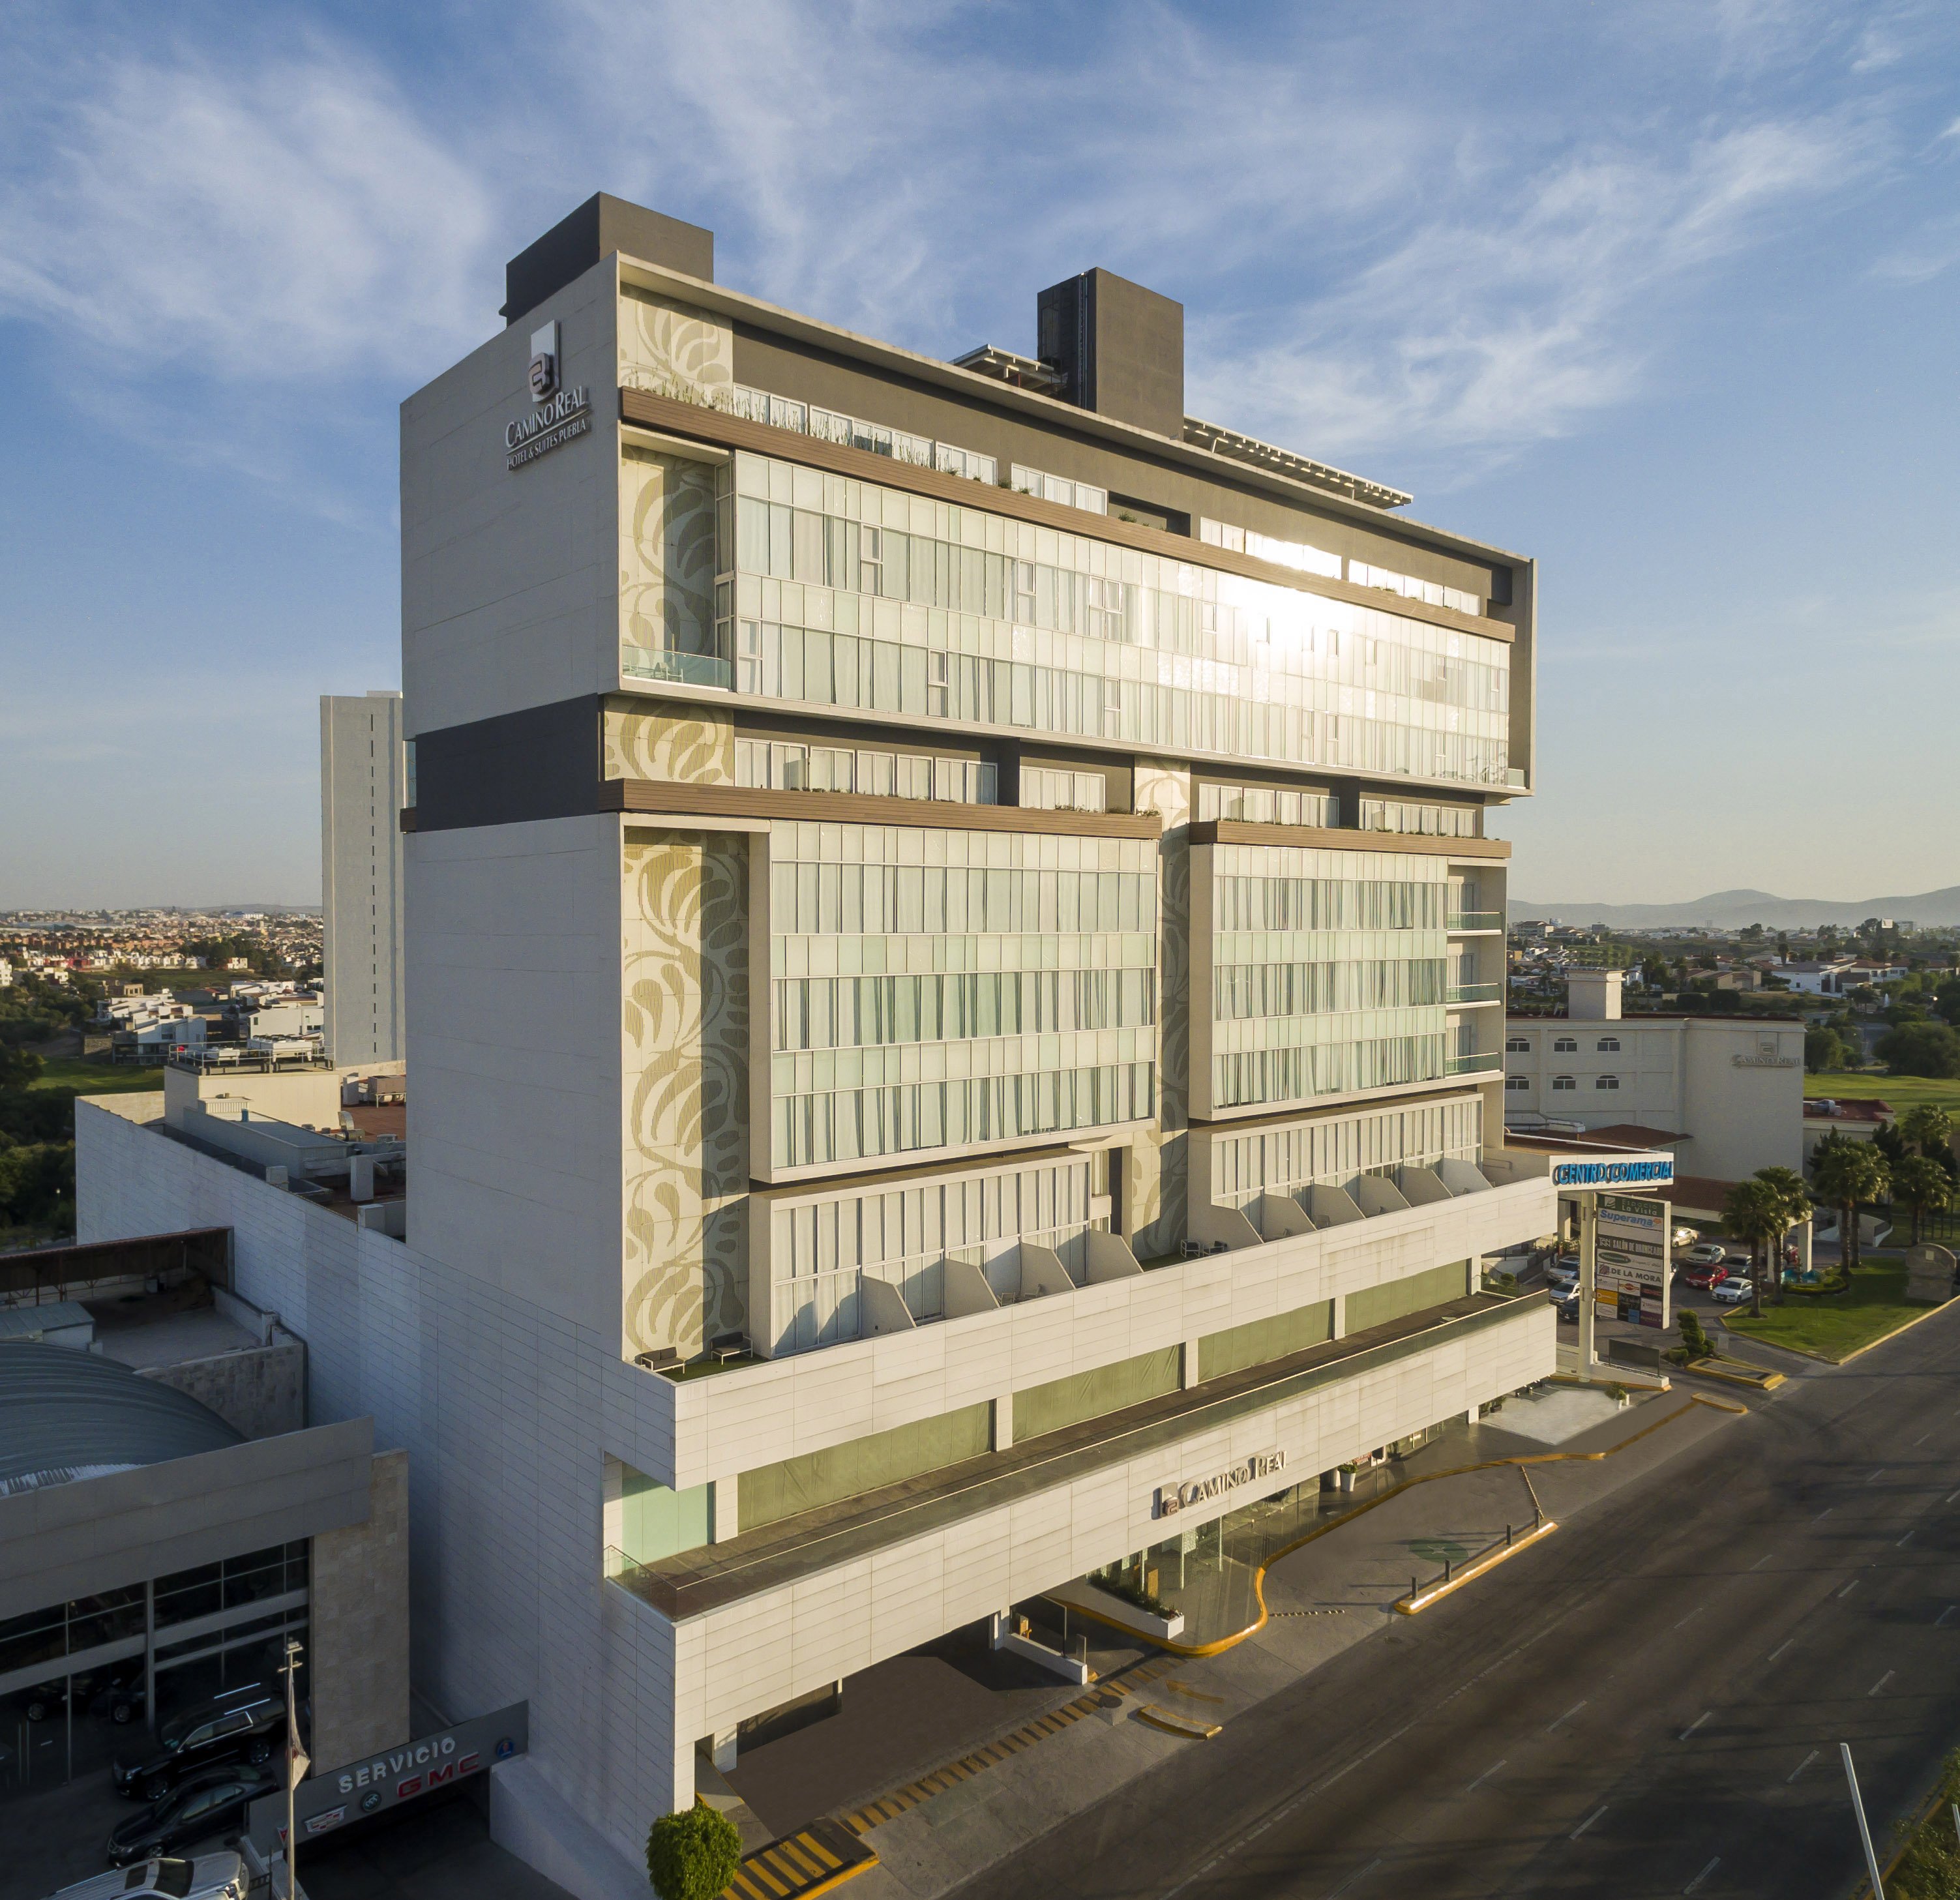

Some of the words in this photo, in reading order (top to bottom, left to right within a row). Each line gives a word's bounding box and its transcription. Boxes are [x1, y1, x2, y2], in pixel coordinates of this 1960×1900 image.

[505, 403, 554, 449] CAMINO
[556, 385, 586, 420] REAL
[507, 449, 528, 470] HOTEL
[528, 446, 535, 458] &
[535, 433, 558, 456] SUITES
[559, 418, 586, 443] PUEBLA
[1732, 1054, 1775, 1065] CAMINO
[1777, 1055, 1801, 1065] REAL
[1556, 1163, 1607, 1185] CENTRO
[1609, 1161, 1674, 1183] COMERCIAL
[1622, 1198, 1657, 1210] Espacio
[1634, 1206, 1657, 1215] Vista
[1600, 1210, 1654, 1226] Superama
[1624, 1269, 1633, 1278] LA
[1635, 1272, 1661, 1283] MORA
[1181, 1467, 1251, 1507] CAMINO
[338, 1736, 456, 1794] SERVICIO
[396, 1752, 480, 1798] GMC
